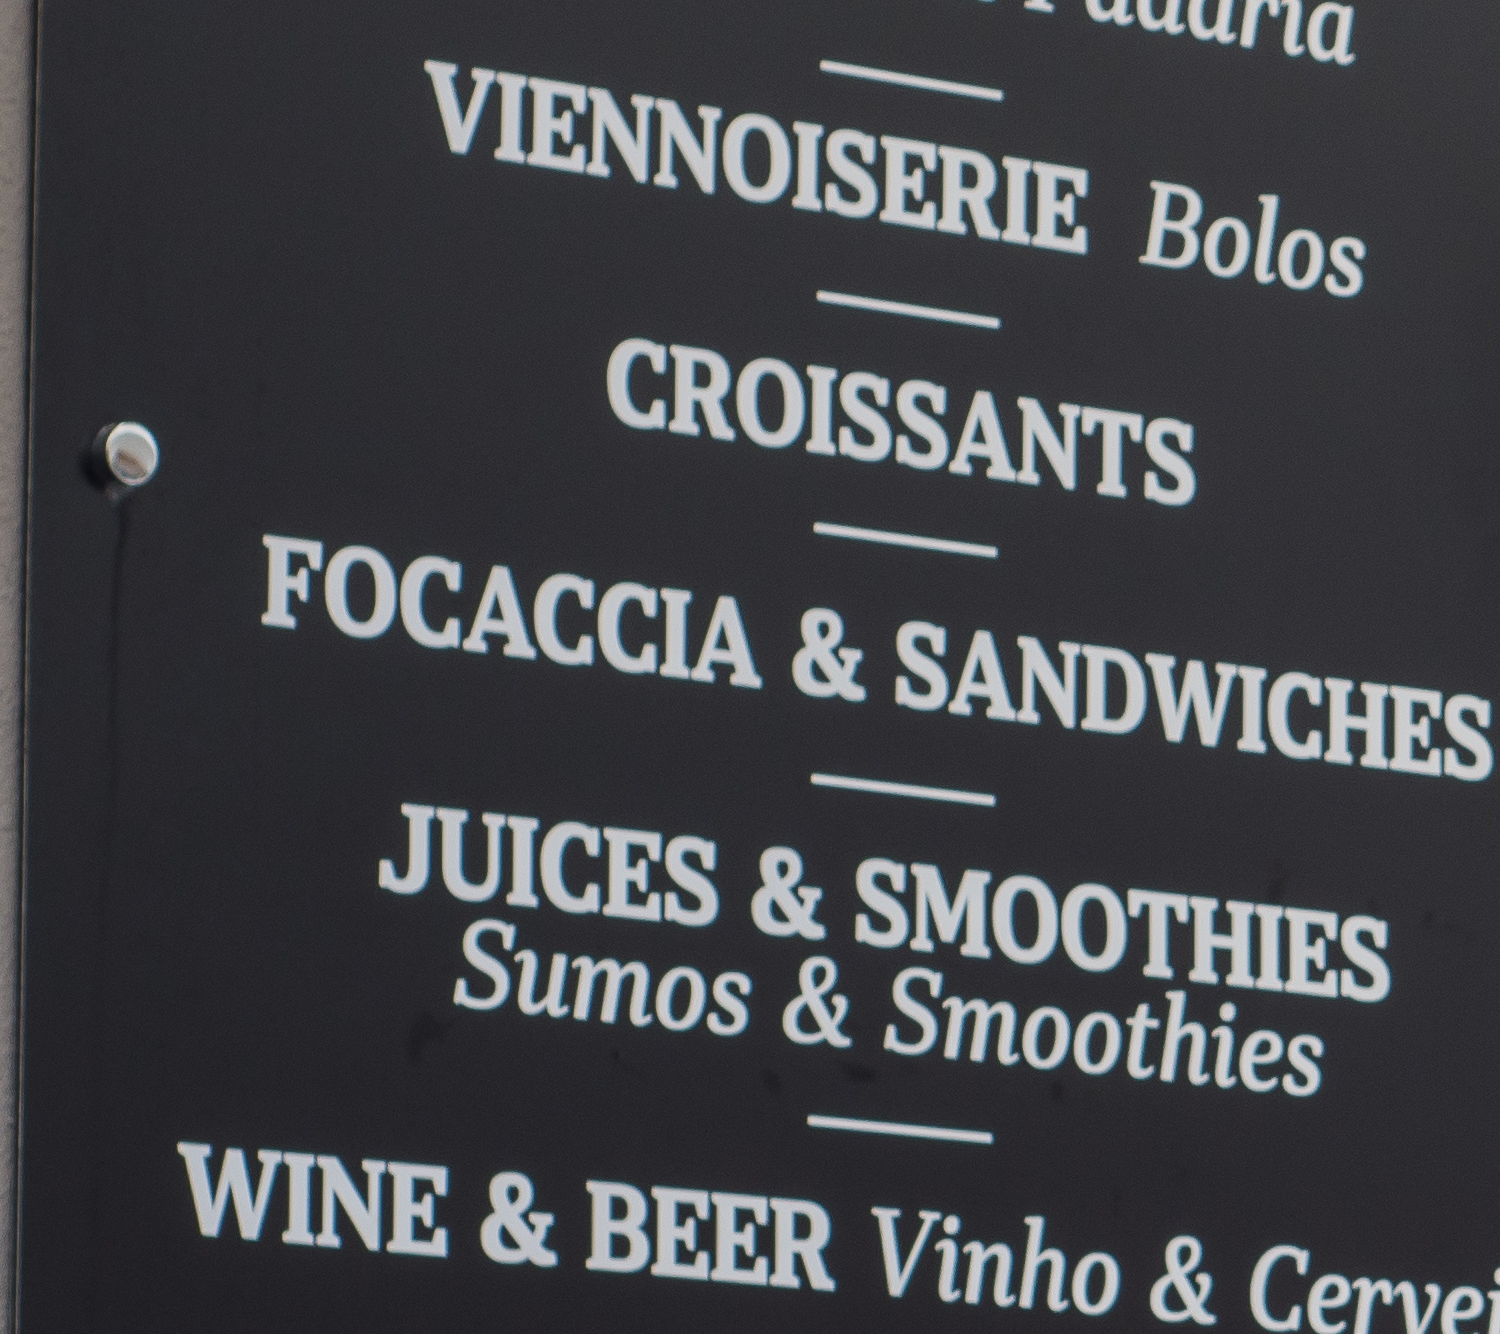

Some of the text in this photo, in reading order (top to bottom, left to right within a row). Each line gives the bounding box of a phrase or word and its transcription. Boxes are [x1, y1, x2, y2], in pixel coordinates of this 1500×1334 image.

[422, 58, 1368, 299] VIENNOISERIE Bolos
[605, 336, 1198, 507] CROISSANTS
[260, 533, 1495, 783] FOCACCIA & SANDWICHES
[377, 801, 1392, 1004] JUICES & SMOOTHIES
[452, 917, 1325, 1098] Sumos & Smoothies
[175, 1140, 450, 1259] WINE
[479, 1170, 559, 1269] &
[584, 1178, 837, 1293] BEER
[869, 1205, 1122, 1317] Vinho
[1148, 1234, 1218, 1327] &
